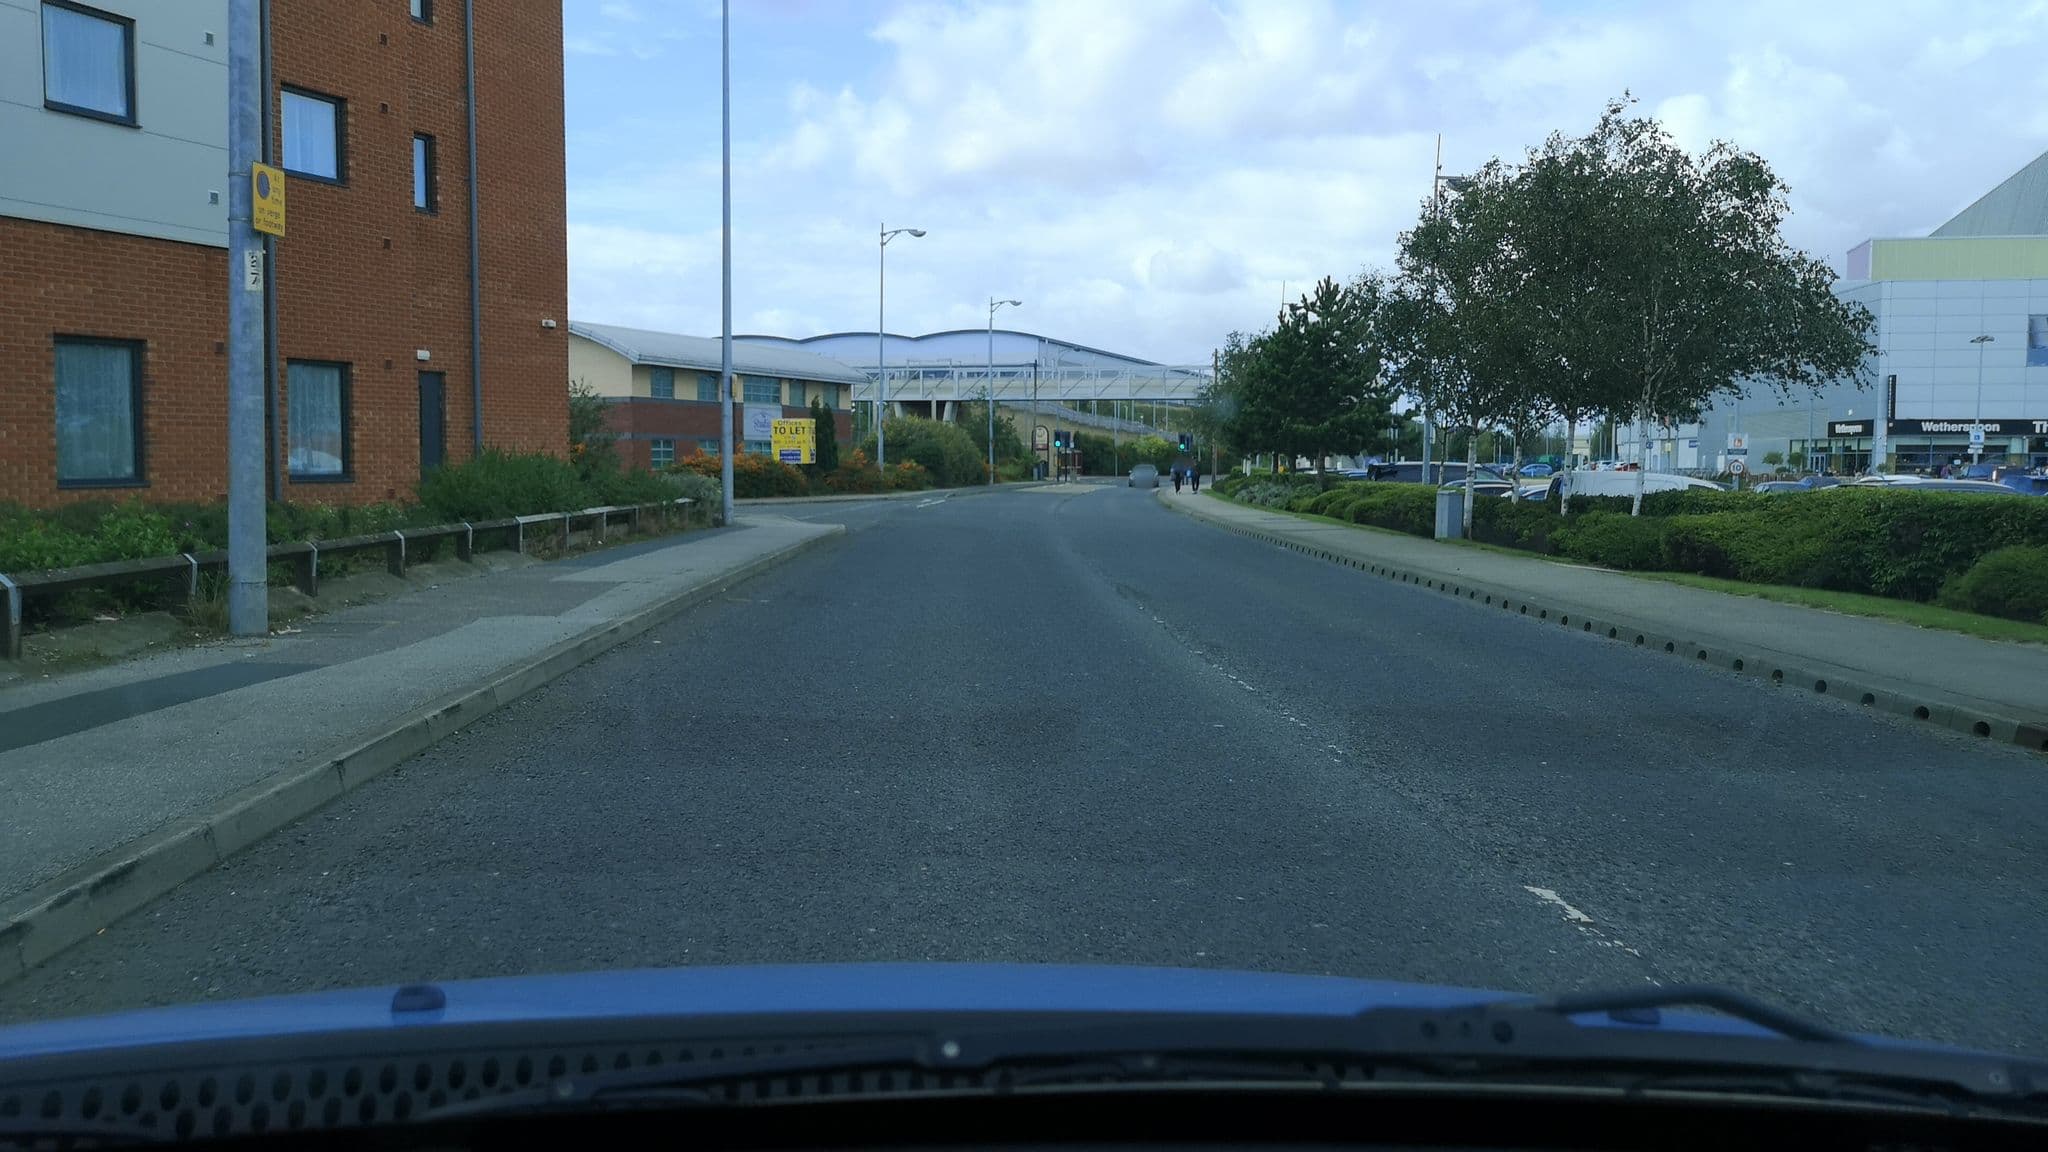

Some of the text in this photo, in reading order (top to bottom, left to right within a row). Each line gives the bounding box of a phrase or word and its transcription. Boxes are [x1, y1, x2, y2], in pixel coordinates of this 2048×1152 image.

[773, 426, 806, 435] TO LET
[1921, 421, 2001, 432] Wetherspoon
